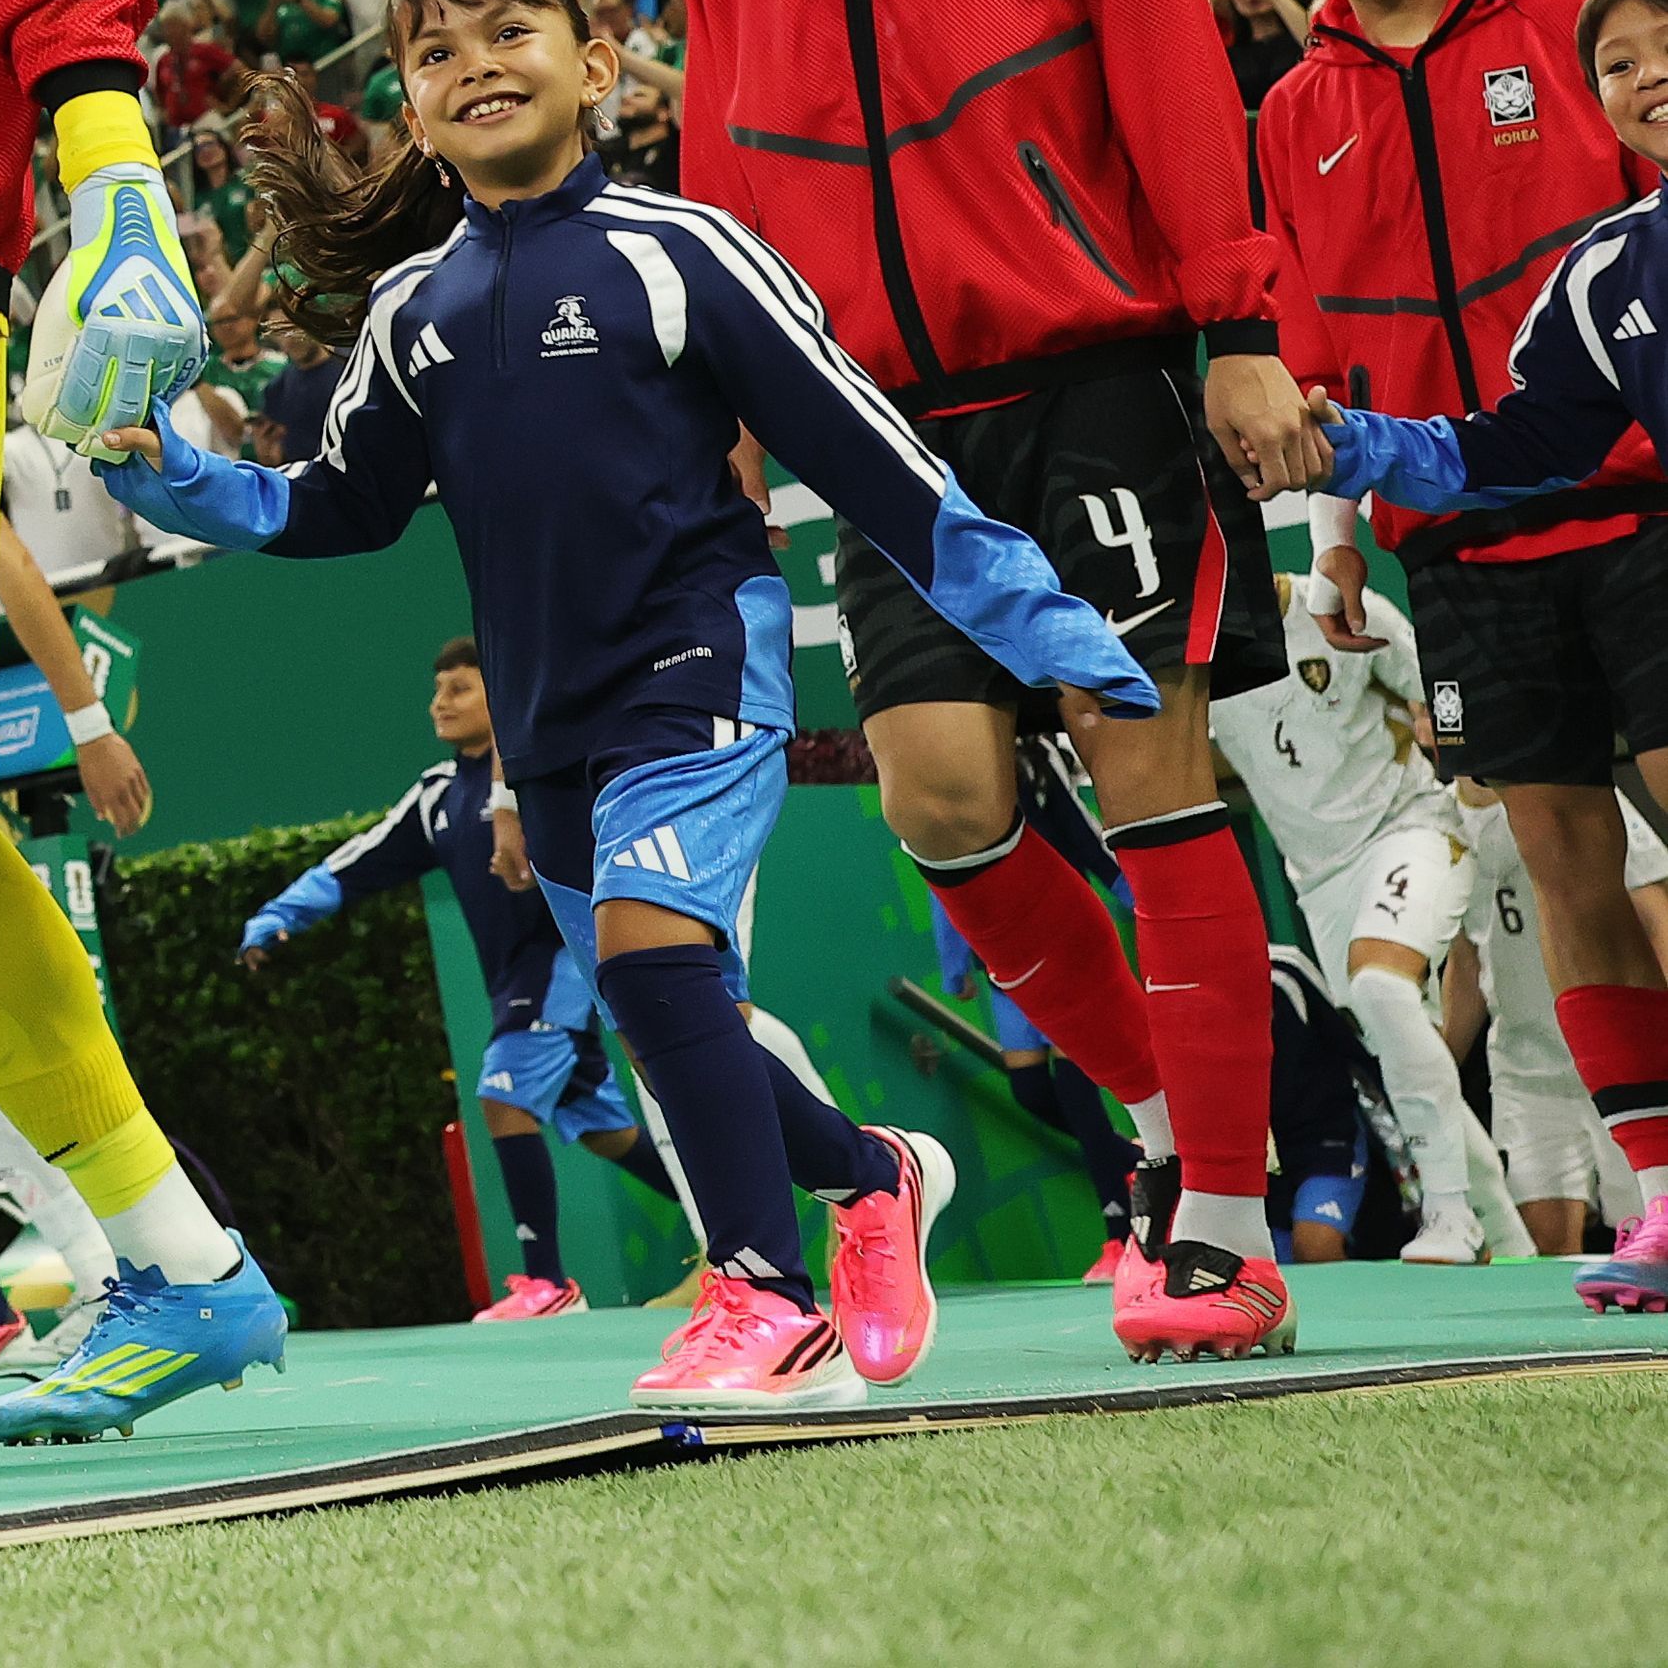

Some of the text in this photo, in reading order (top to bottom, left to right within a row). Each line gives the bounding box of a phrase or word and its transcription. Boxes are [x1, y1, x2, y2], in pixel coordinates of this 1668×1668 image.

[1492, 127, 1540, 147] KOREA
[541, 326, 599, 345] QUAKER
[1079, 487, 1161, 600] 4
[653, 646, 713, 672] FORMOTION
[1274, 720, 1302, 769] 4
[1496, 887, 1525, 936] 6
